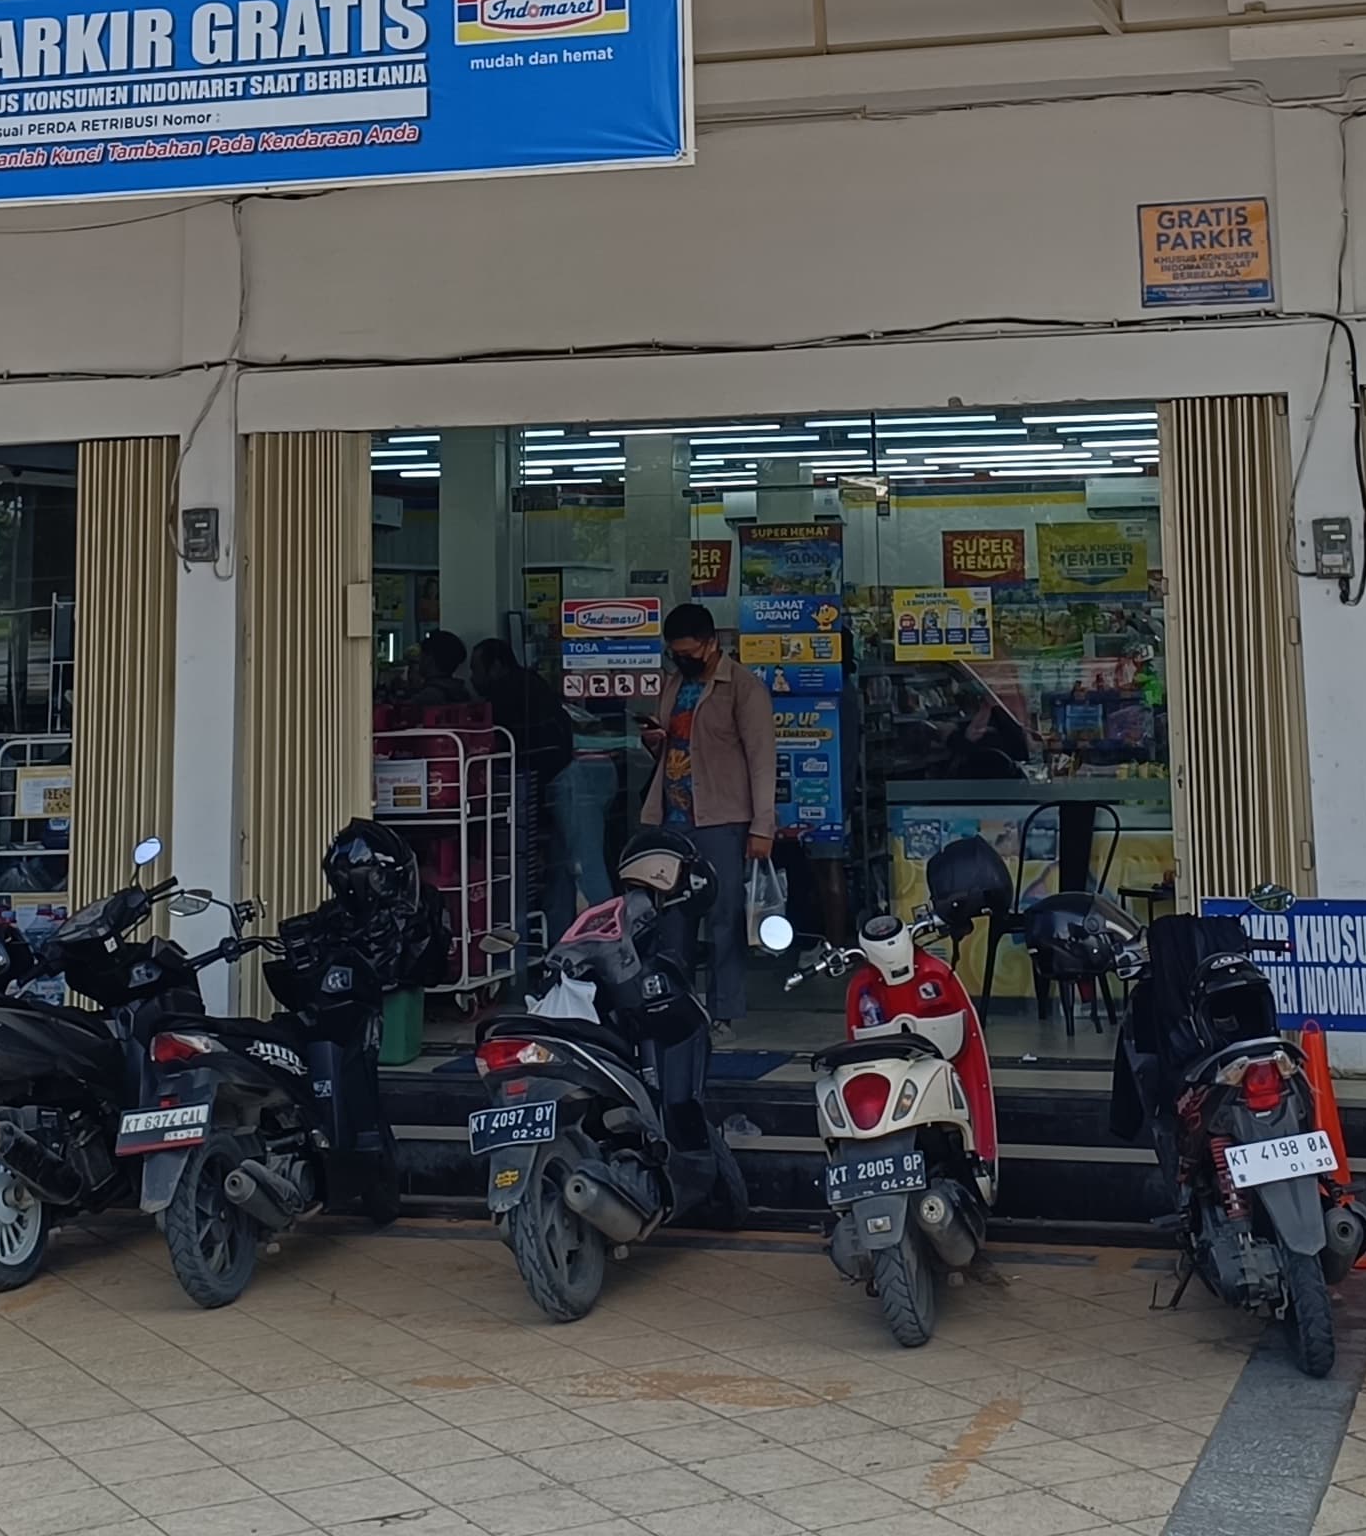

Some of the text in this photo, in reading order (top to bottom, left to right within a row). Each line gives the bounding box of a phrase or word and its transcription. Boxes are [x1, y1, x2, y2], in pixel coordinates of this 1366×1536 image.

[470, 46, 614, 70] mudah dan hemat
[23, 84, 128, 112] KONSUMEN
[132, 76, 247, 104] INDOMARET
[250, 72, 300, 95] SAAT
[304, 63, 427, 92] BERBELANJA
[28, 120, 77, 136] PERDA
[81, 114, 158, 132] RETRIBUSI
[162, 112, 211, 127] Nomor
[51, 144, 103, 165] Kunci
[109, 137, 202, 161] Tambahan
[207, 133, 253, 154] Pada
[259, 128, 361, 151] Kendaraan
[365, 121, 418, 144] Anda
[1157, 206, 1248, 230] GRATIS
[1156, 227, 1253, 252] PARKIR
[691, 549, 722, 564] PER
[953, 538, 1015, 555] SUPER
[953, 554, 1016, 570] HEMAT
[1050, 552, 1134, 567] MEMBER
[752, 600, 805, 610] SELAMAT
[755, 610, 801, 621] DATANG
[568, 643, 600, 653] TOSA
[773, 712, 821, 727] OP UP
[124, 1107, 203, 1134] KT 6374 CAL
[471, 1115, 487, 1134] KT
[491, 1108, 525, 1129] 4097
[1229, 1148, 1249, 1166] KT
[1260, 1139, 1299, 1160] 4198
[829, 1165, 848, 1186] KT
[857, 1157, 895, 1180] 2805
